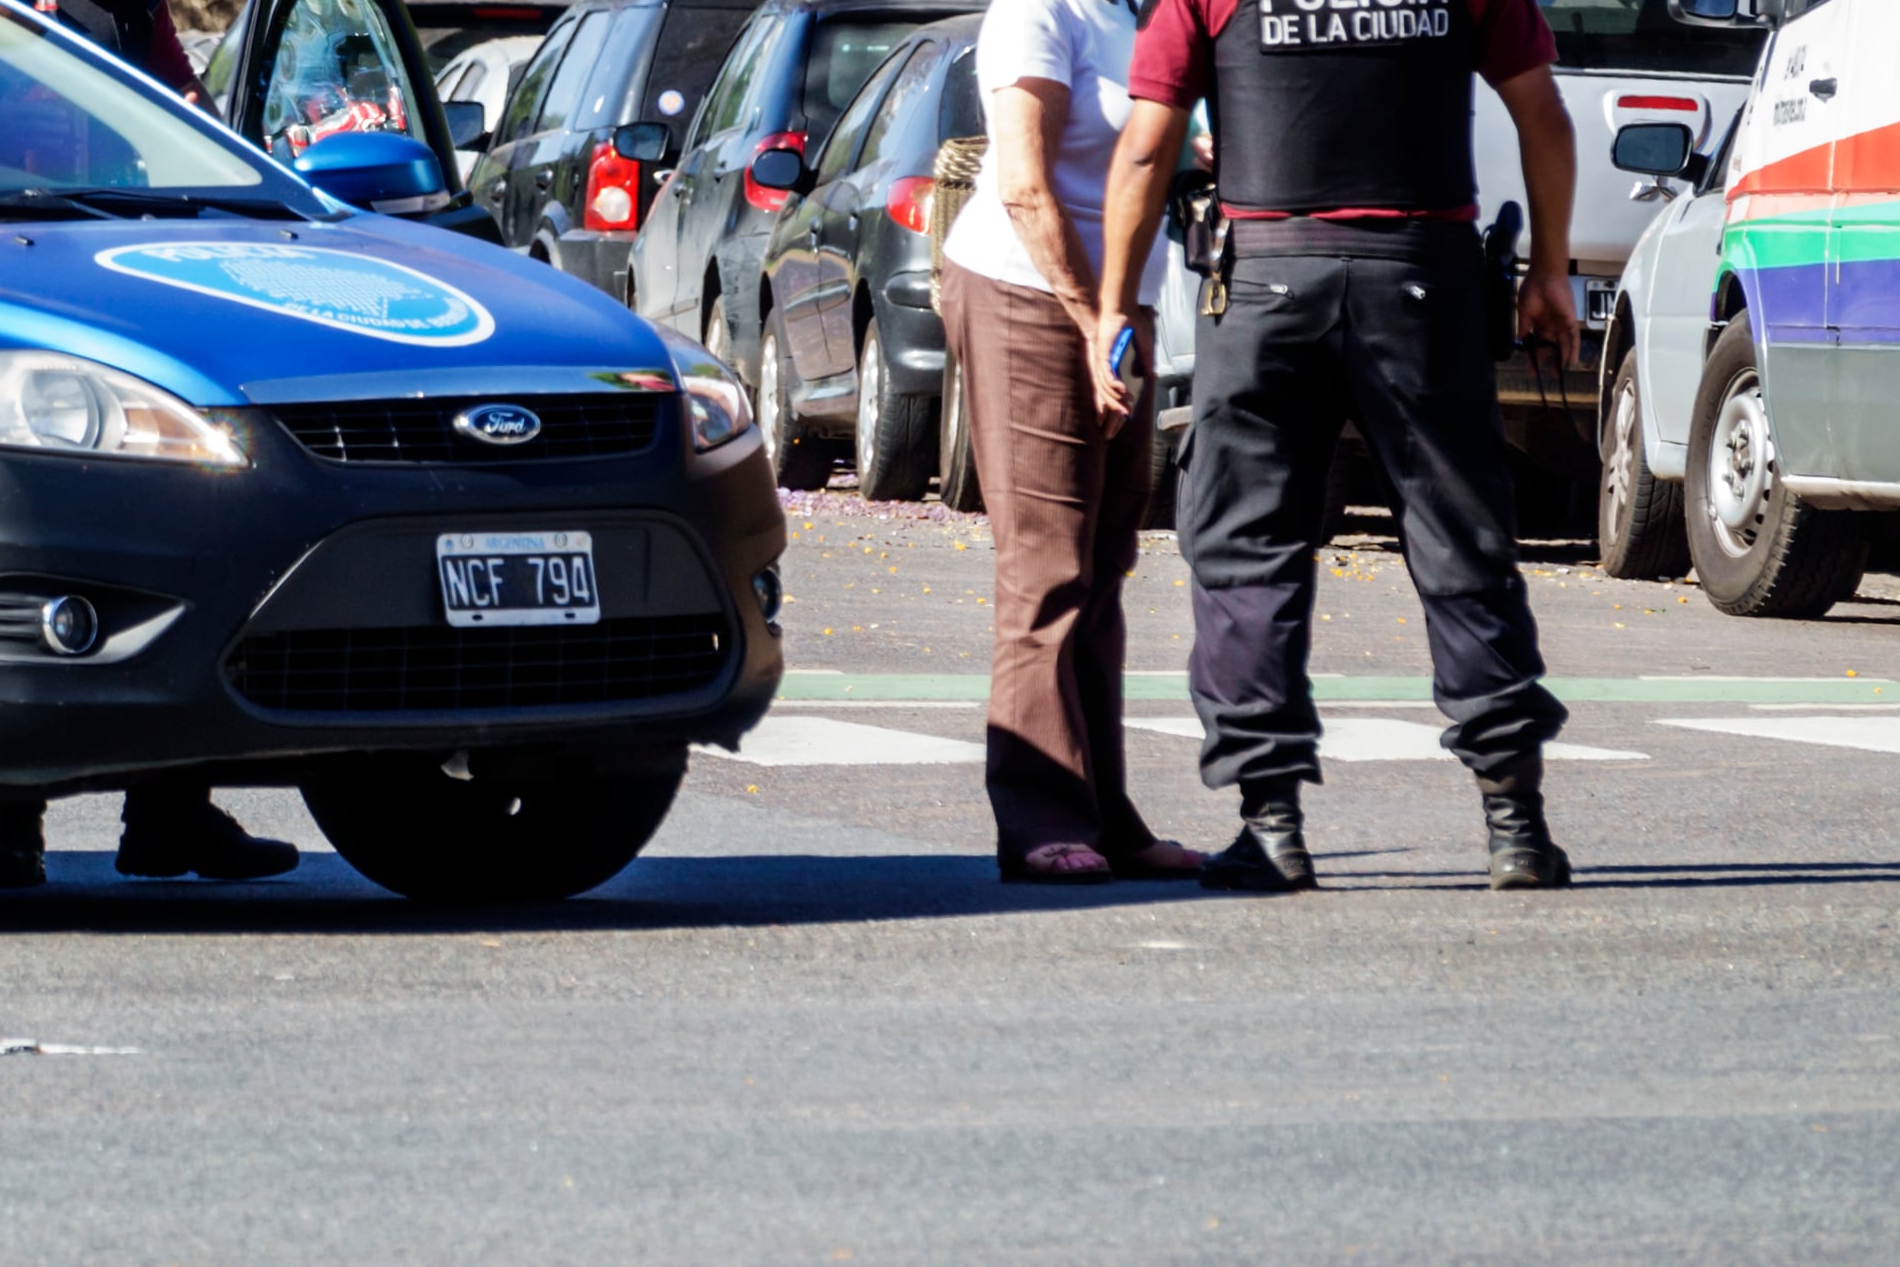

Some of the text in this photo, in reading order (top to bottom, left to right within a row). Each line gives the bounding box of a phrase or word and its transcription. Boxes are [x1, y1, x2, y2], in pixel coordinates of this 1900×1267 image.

[1262, 8, 1449, 45] DE LA CIUDAD
[484, 412, 525, 434] Ford
[445, 556, 591, 607] NCF 794
